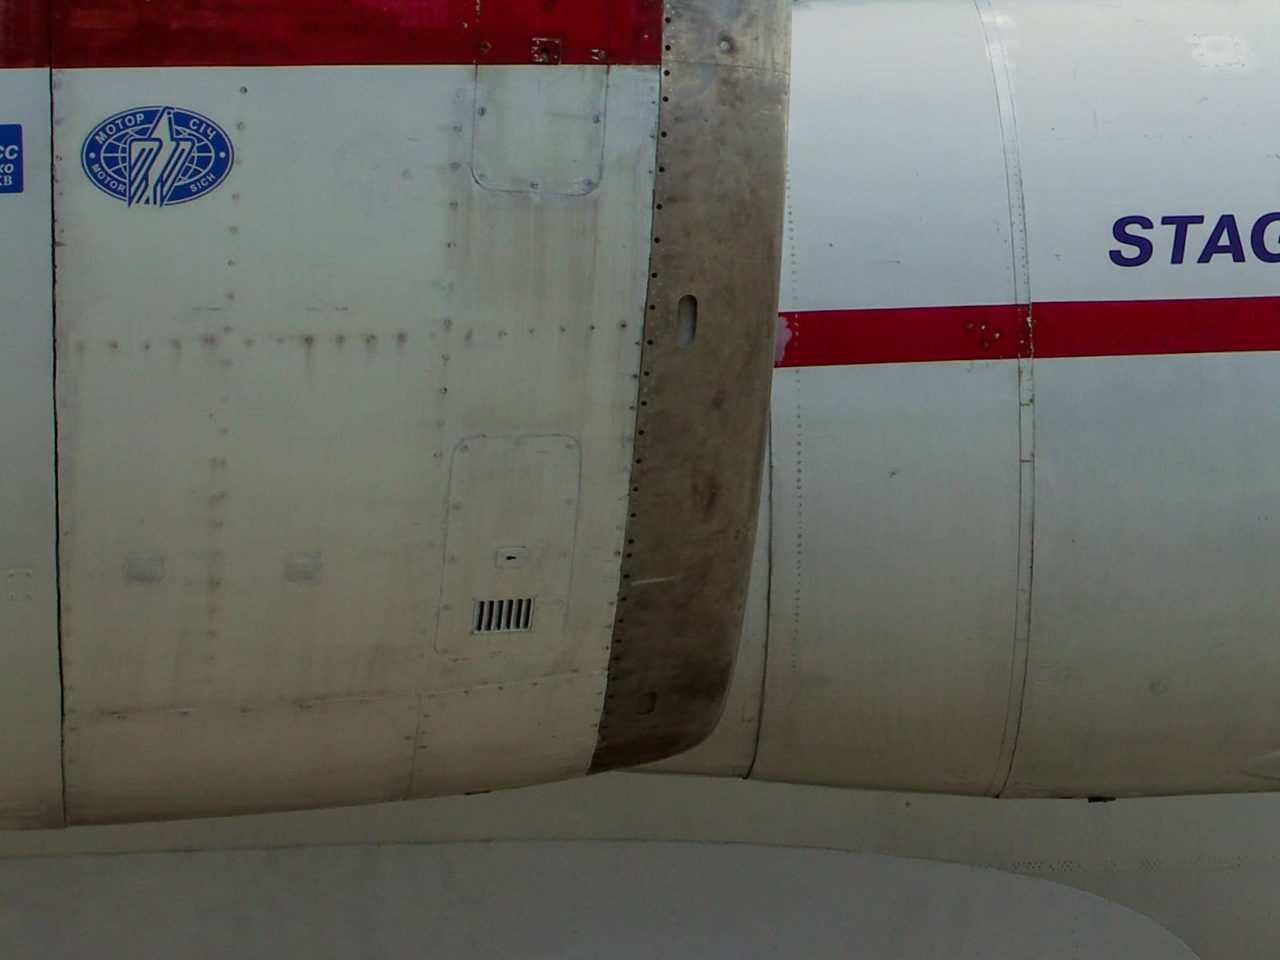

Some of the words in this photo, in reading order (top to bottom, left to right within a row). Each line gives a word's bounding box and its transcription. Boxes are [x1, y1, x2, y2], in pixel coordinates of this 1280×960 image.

[95, 113, 145, 144] МОТОР
[91, 163, 127, 193] MOTOR
[190, 172, 216, 193] SICH
